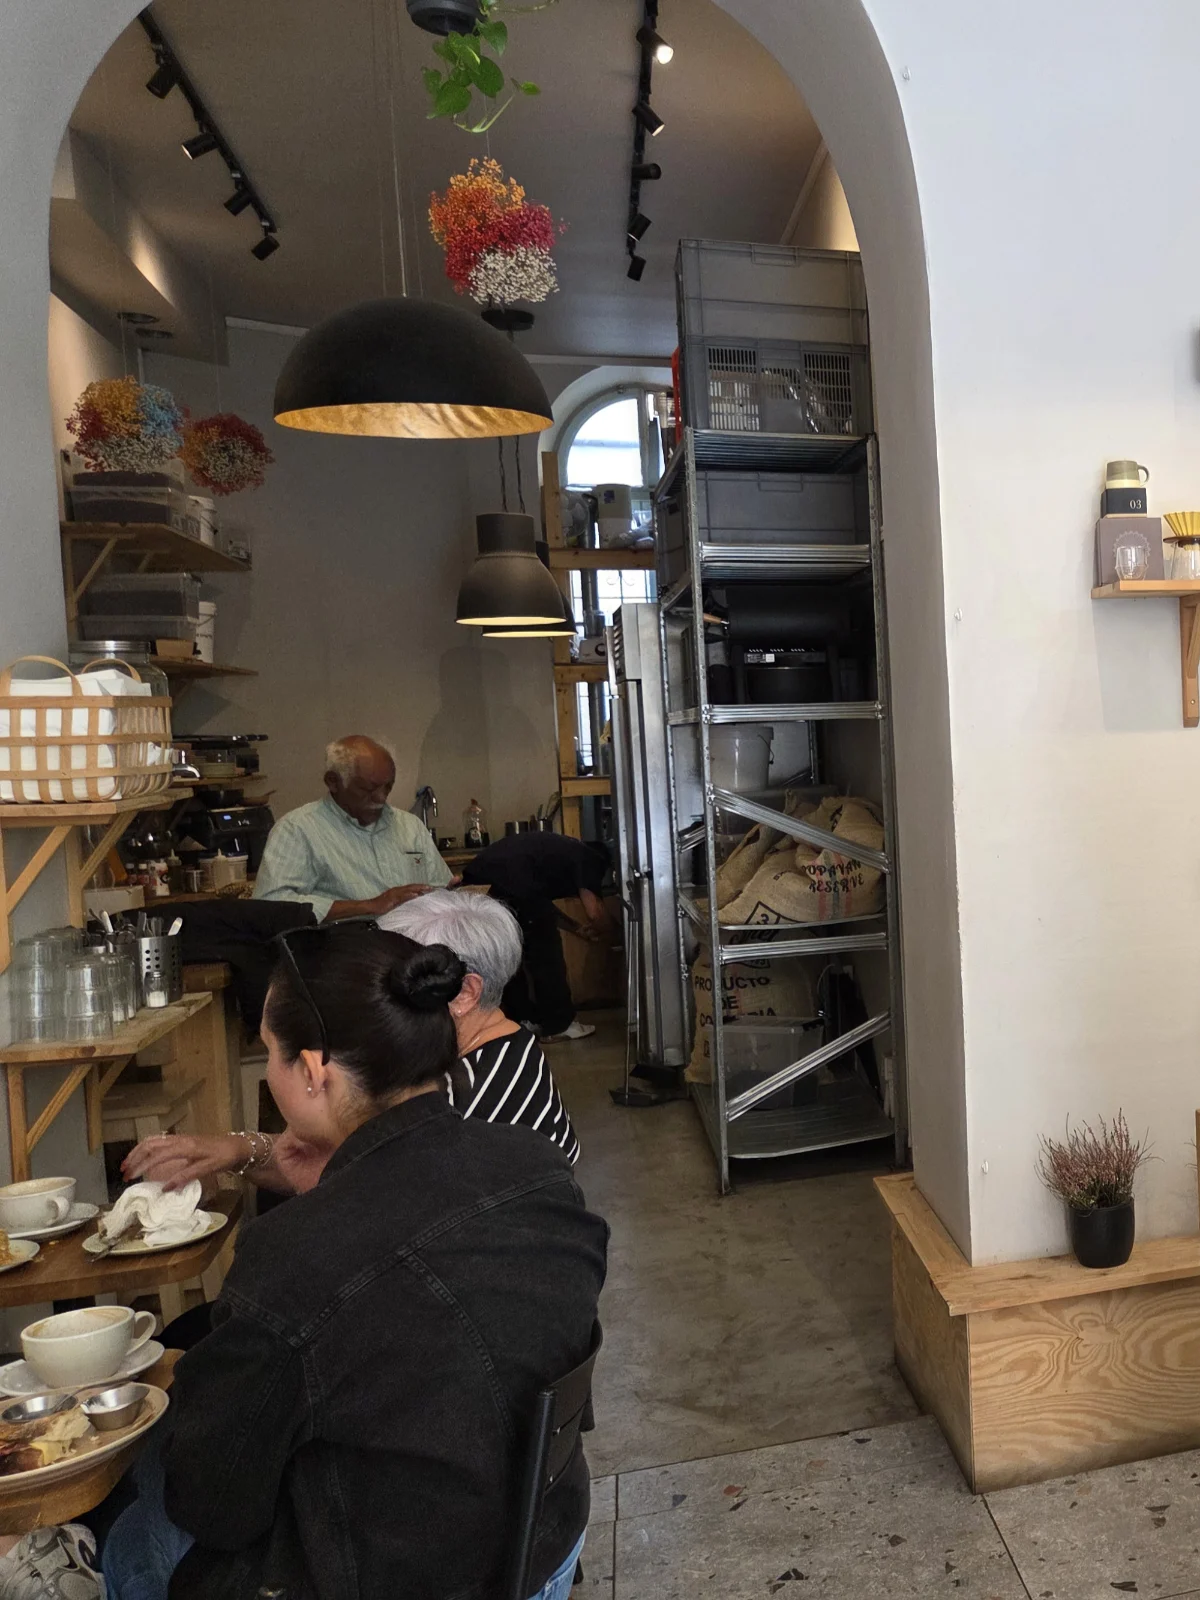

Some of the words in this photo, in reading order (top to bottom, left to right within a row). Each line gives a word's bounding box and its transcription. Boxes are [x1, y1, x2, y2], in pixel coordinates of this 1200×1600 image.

[1130, 500, 1142, 509] 03
[809, 874, 864, 893] RESERVE
[695, 976, 770, 992] PROUCTO
